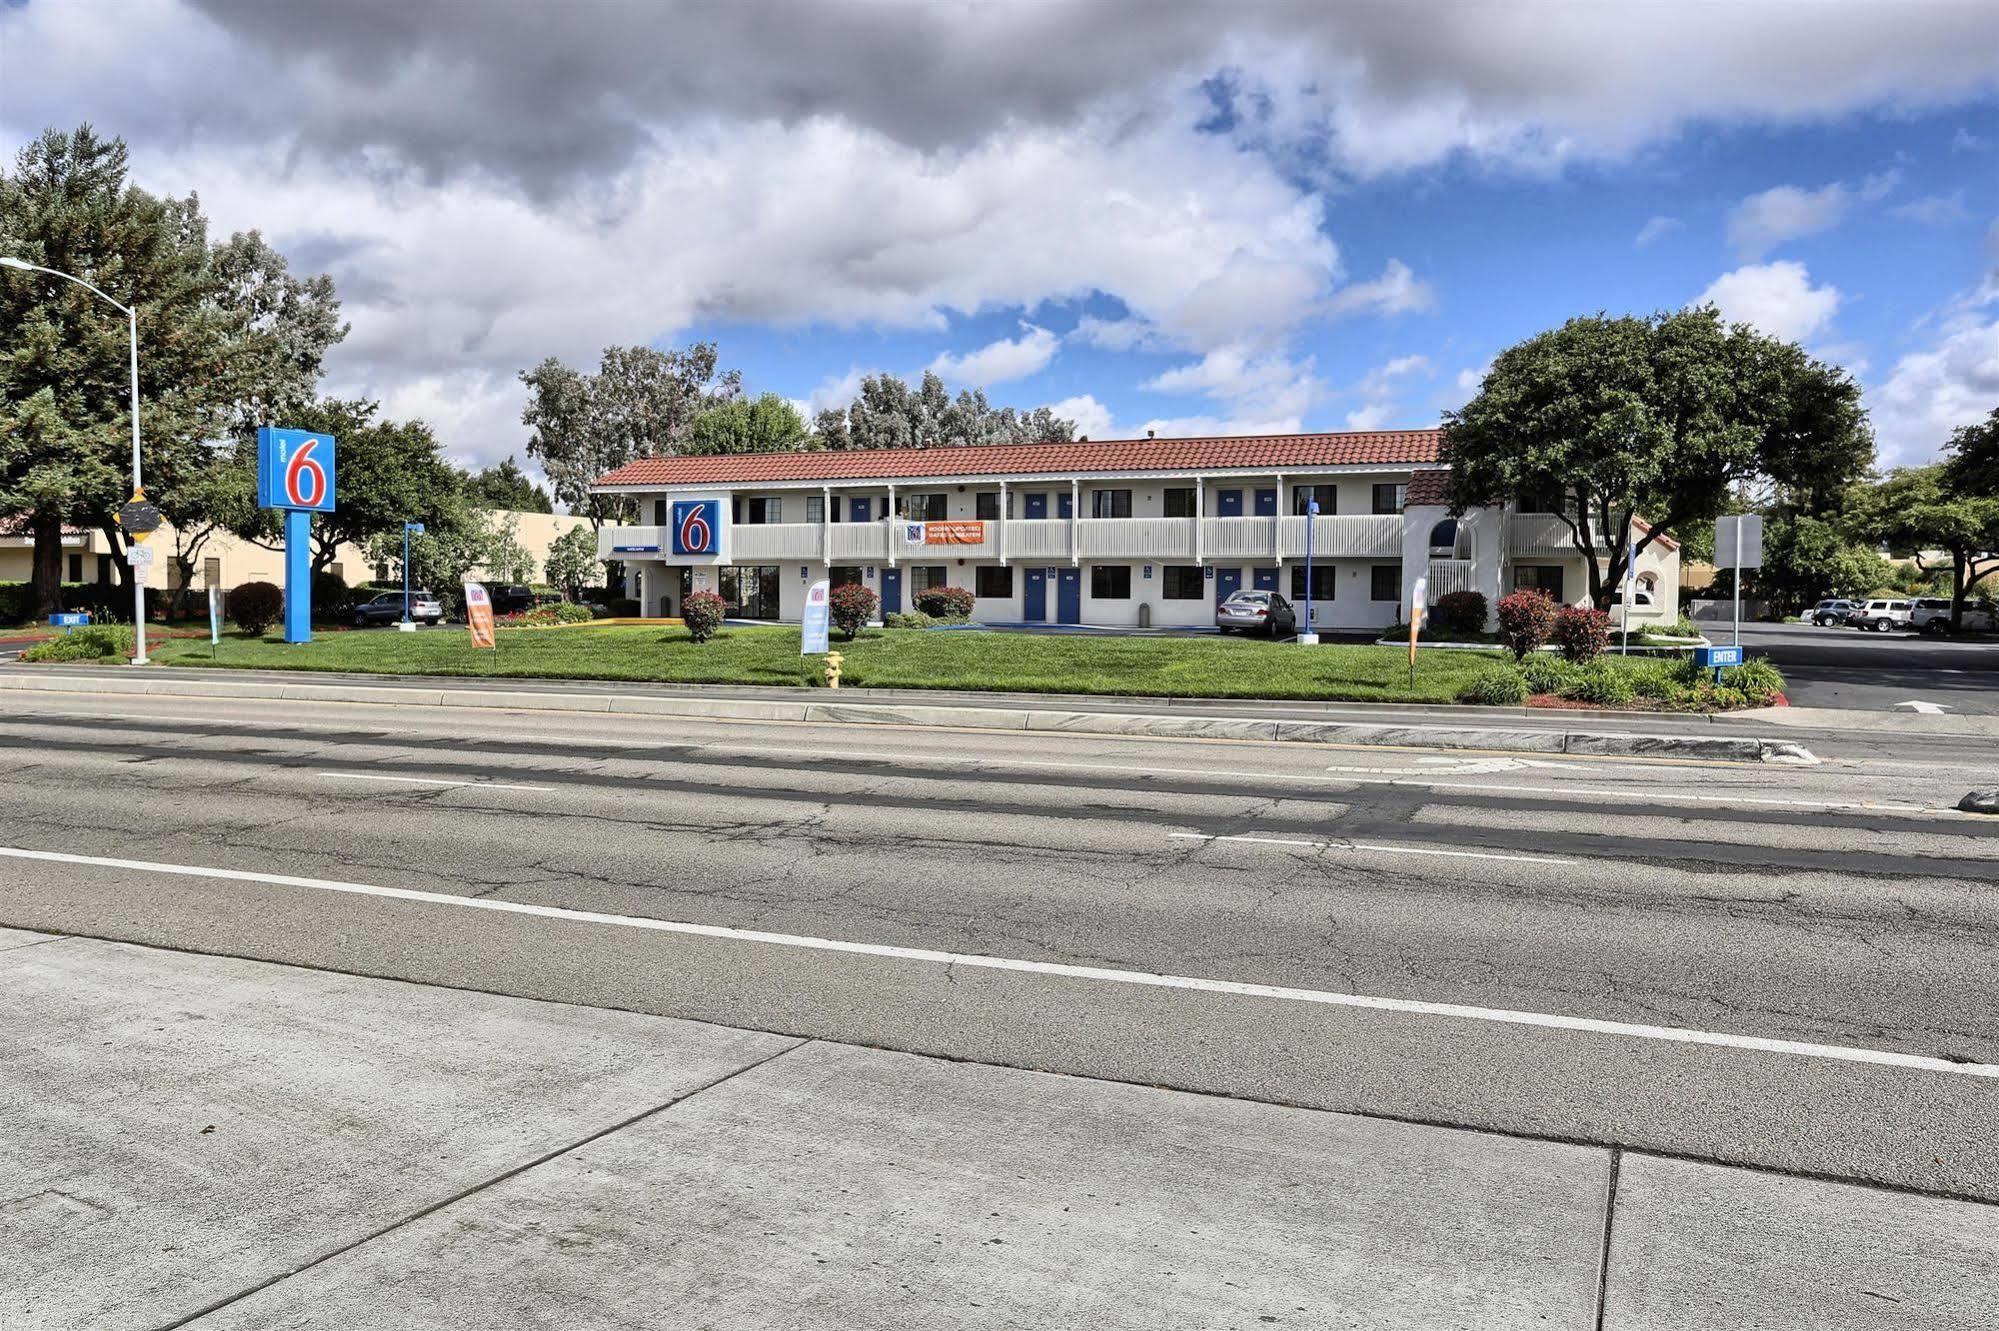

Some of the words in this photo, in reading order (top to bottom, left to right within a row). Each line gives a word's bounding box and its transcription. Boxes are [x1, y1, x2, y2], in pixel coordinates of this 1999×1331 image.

[285, 438, 327, 507] 6
[681, 504, 711, 552] 6
[63, 613, 80, 625] EXIT
[1713, 650, 1737, 663] ENTER
